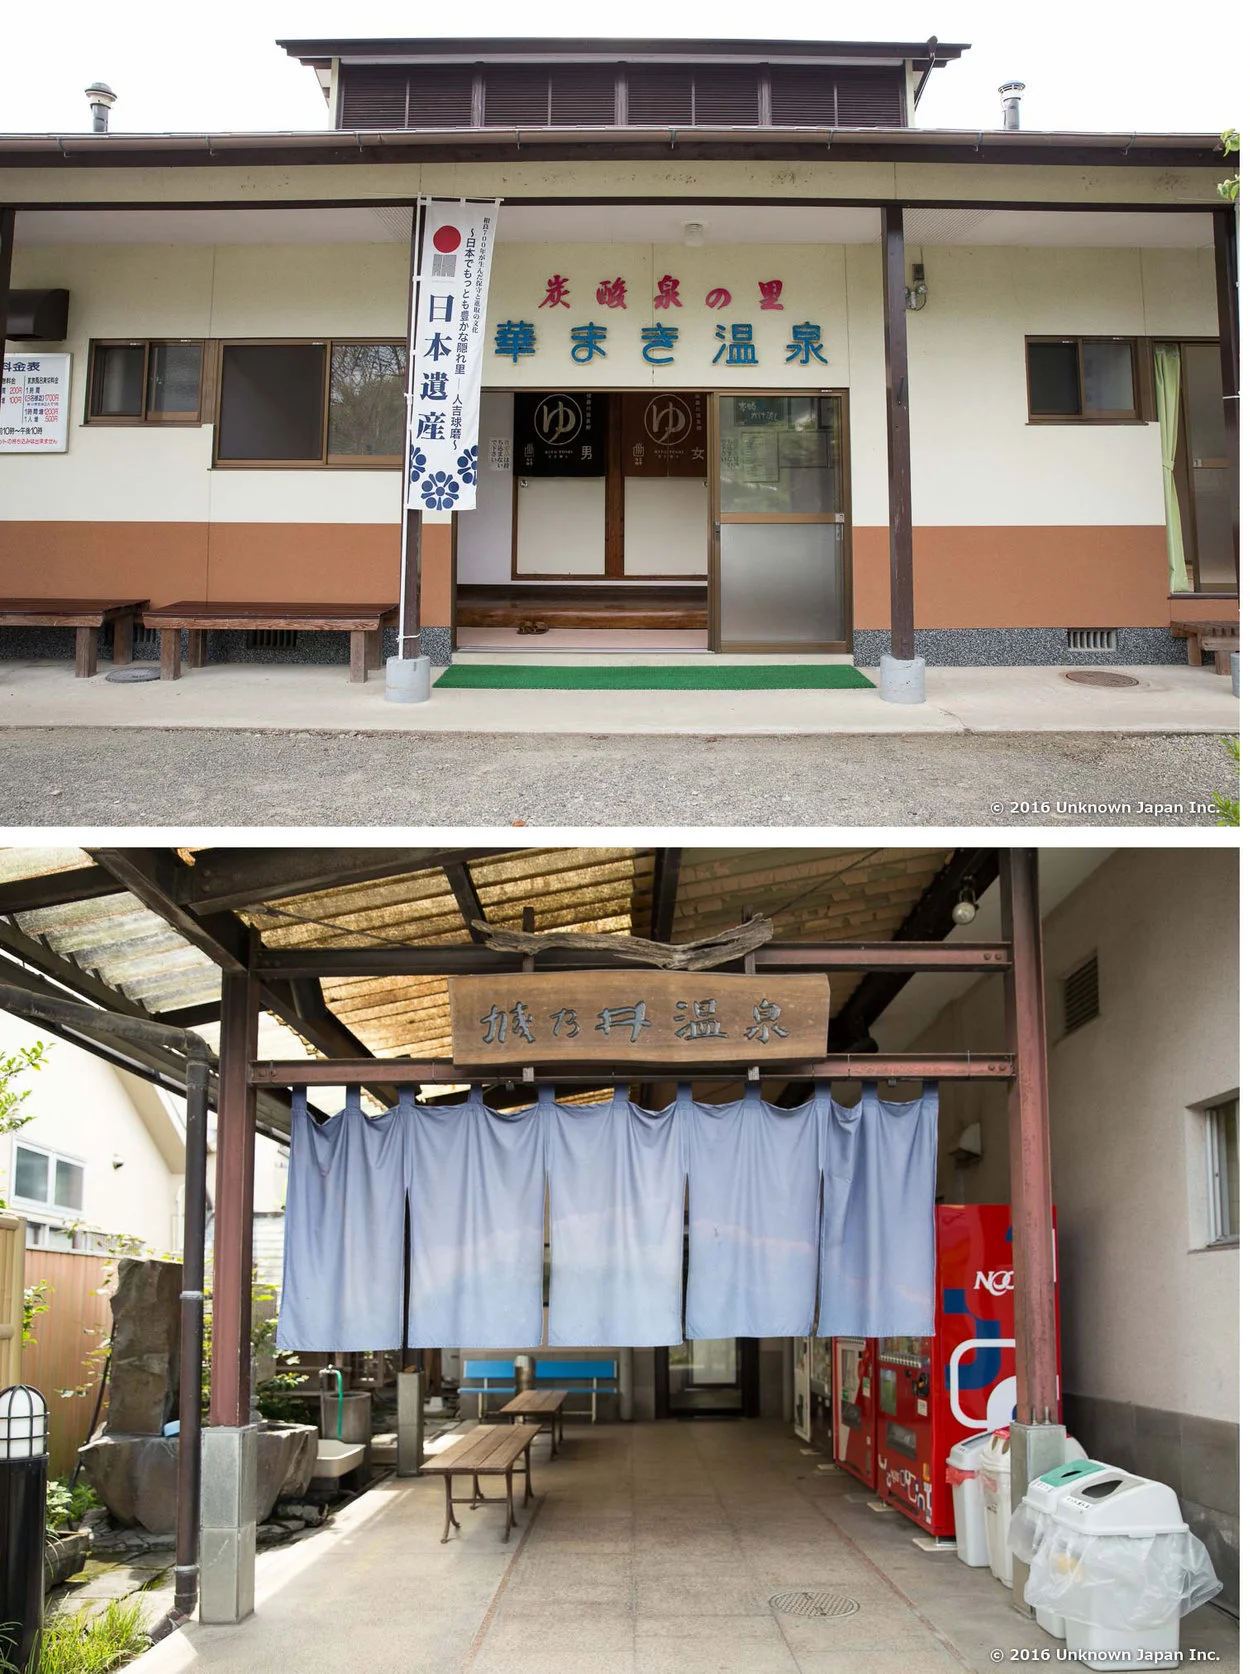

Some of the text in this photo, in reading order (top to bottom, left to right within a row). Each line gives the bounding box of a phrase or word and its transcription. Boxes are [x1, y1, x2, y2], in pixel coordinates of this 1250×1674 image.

[538, 274, 785, 310] 炭酸泉の里
[494, 320, 828, 366] 華まき温泉
[416, 294, 455, 440] 日本遺産
[581, 445, 593, 460] 男
[691, 447, 705, 460] 女
